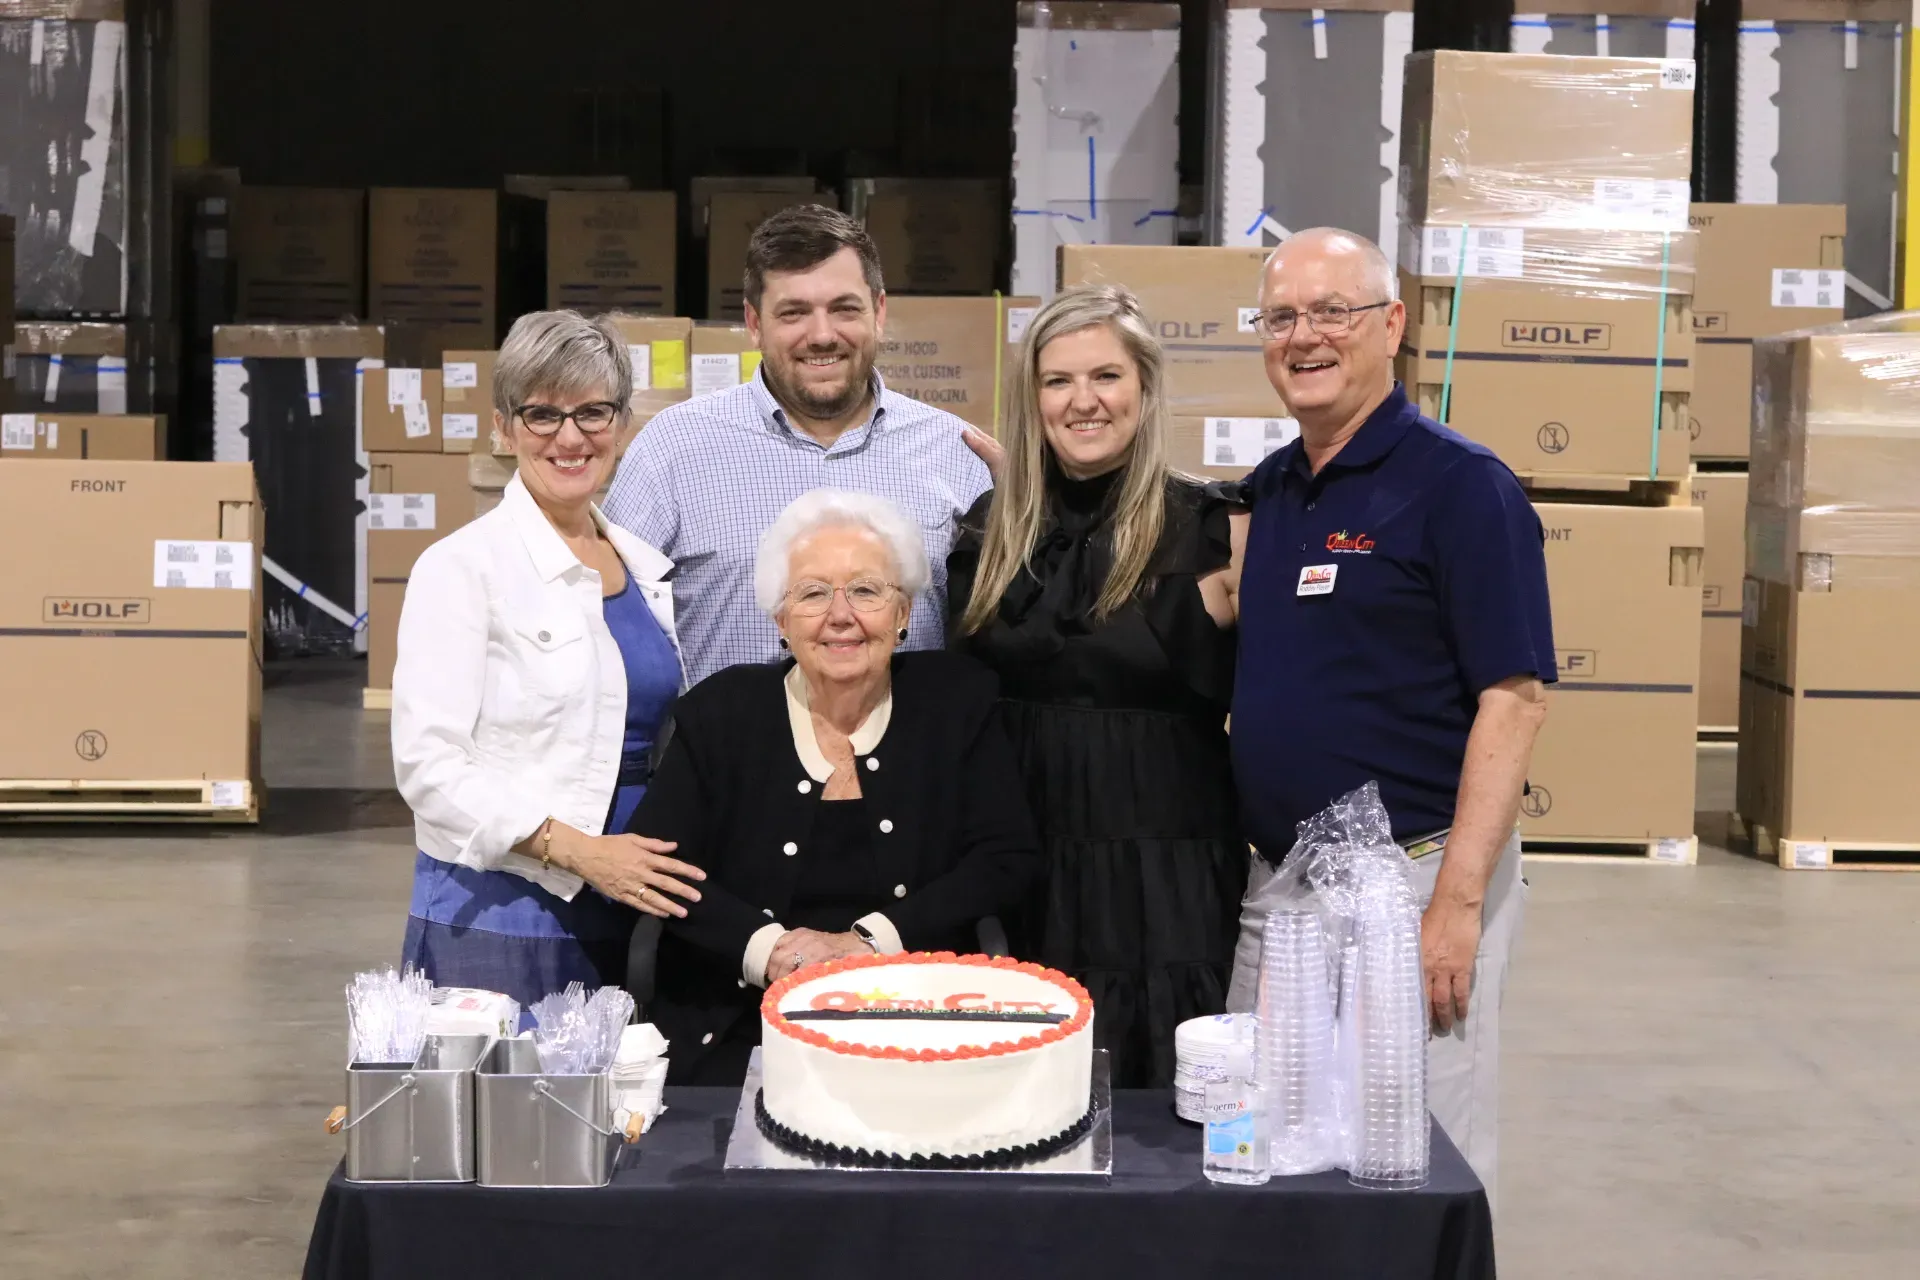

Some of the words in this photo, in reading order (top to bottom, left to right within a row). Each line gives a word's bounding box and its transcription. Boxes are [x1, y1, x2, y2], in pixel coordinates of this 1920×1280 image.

[1688, 216, 1714, 226] ONT
[1153, 321, 1220, 339] OLF
[1510, 325, 1602, 345] WOLF
[904, 341, 938, 355] HOOD
[913, 366, 962, 379] CUISINE
[923, 389, 968, 402] COCINA
[71, 480, 126, 492] FRONT
[53, 601, 141, 618] WOLF
[943, 993, 1057, 1013] CITY
